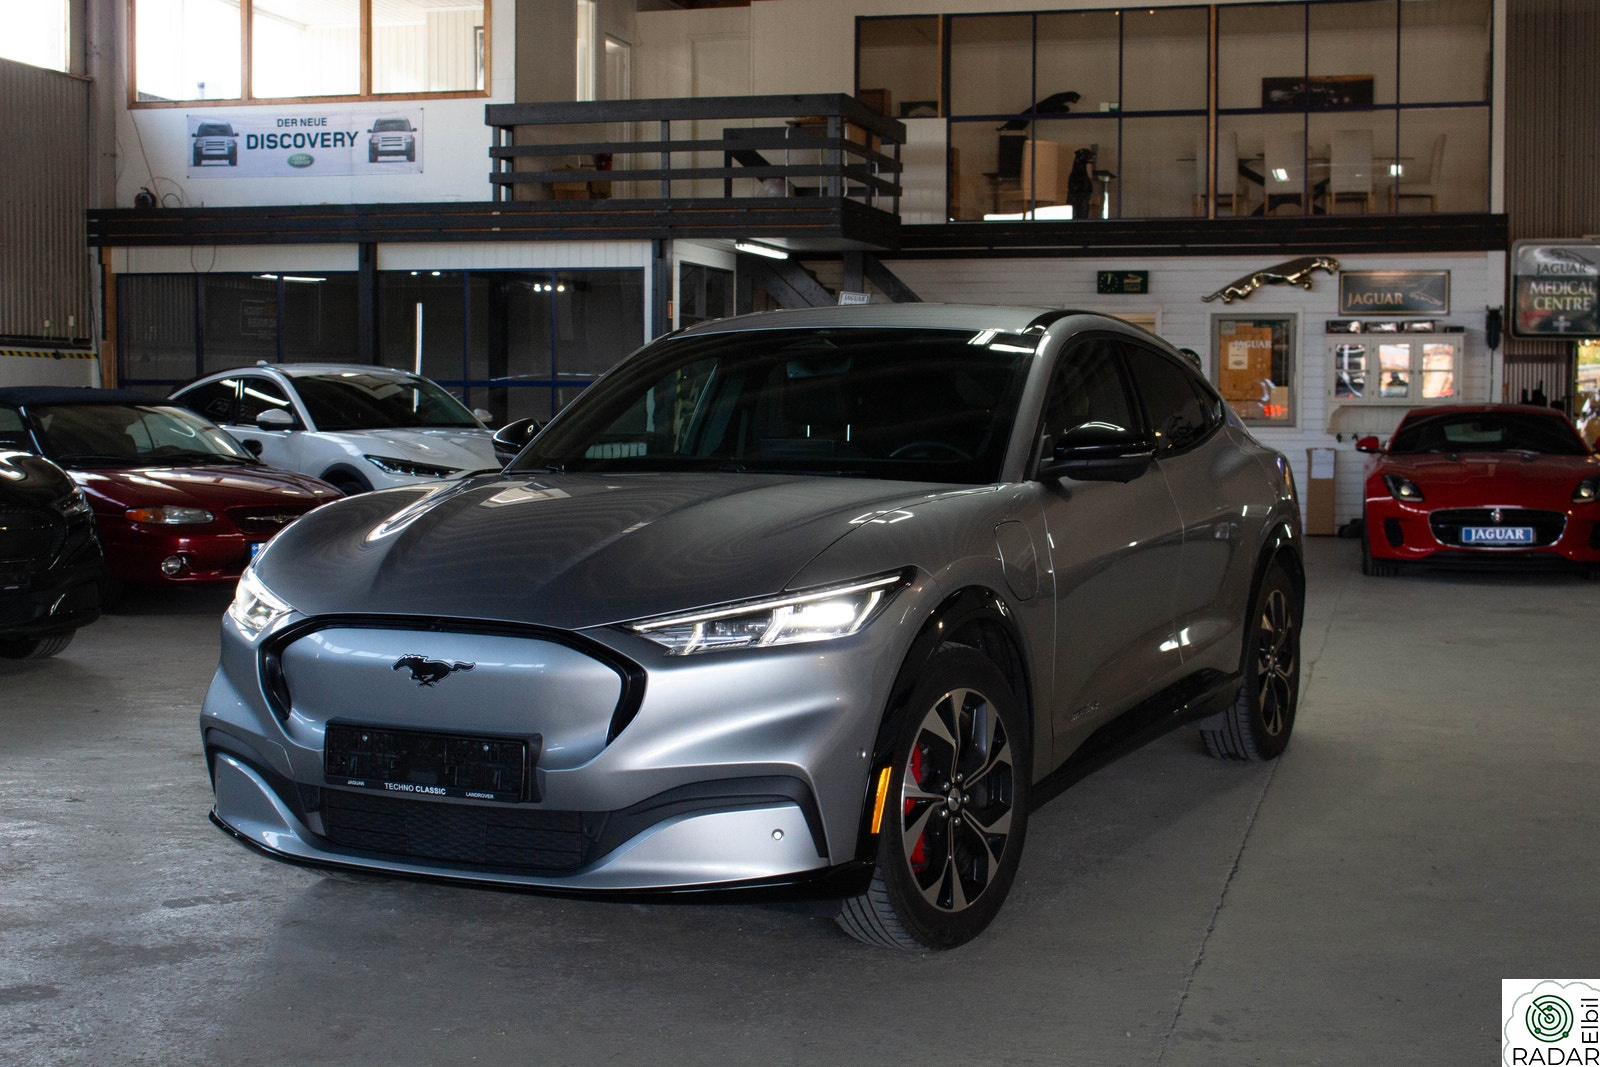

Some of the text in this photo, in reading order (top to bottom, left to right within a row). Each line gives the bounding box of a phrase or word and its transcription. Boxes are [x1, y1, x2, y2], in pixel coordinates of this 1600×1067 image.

[277, 117, 328, 128] DER NEUE
[246, 131, 358, 150] DISCOVERY
[1537, 263, 1586, 276] JAGUAR
[1530, 281, 1595, 296] MEDICAL
[1347, 291, 1404, 307] JAGUAR
[1533, 296, 1592, 311] CENTRE
[1233, 340, 1272, 349] JAGUAR
[1470, 528, 1525, 542] JAGUAR
[347, 779, 365, 787] JAGUAR
[384, 782, 446, 796] TECHNO CLASSIC
[465, 791, 495, 799] LANDROVER
